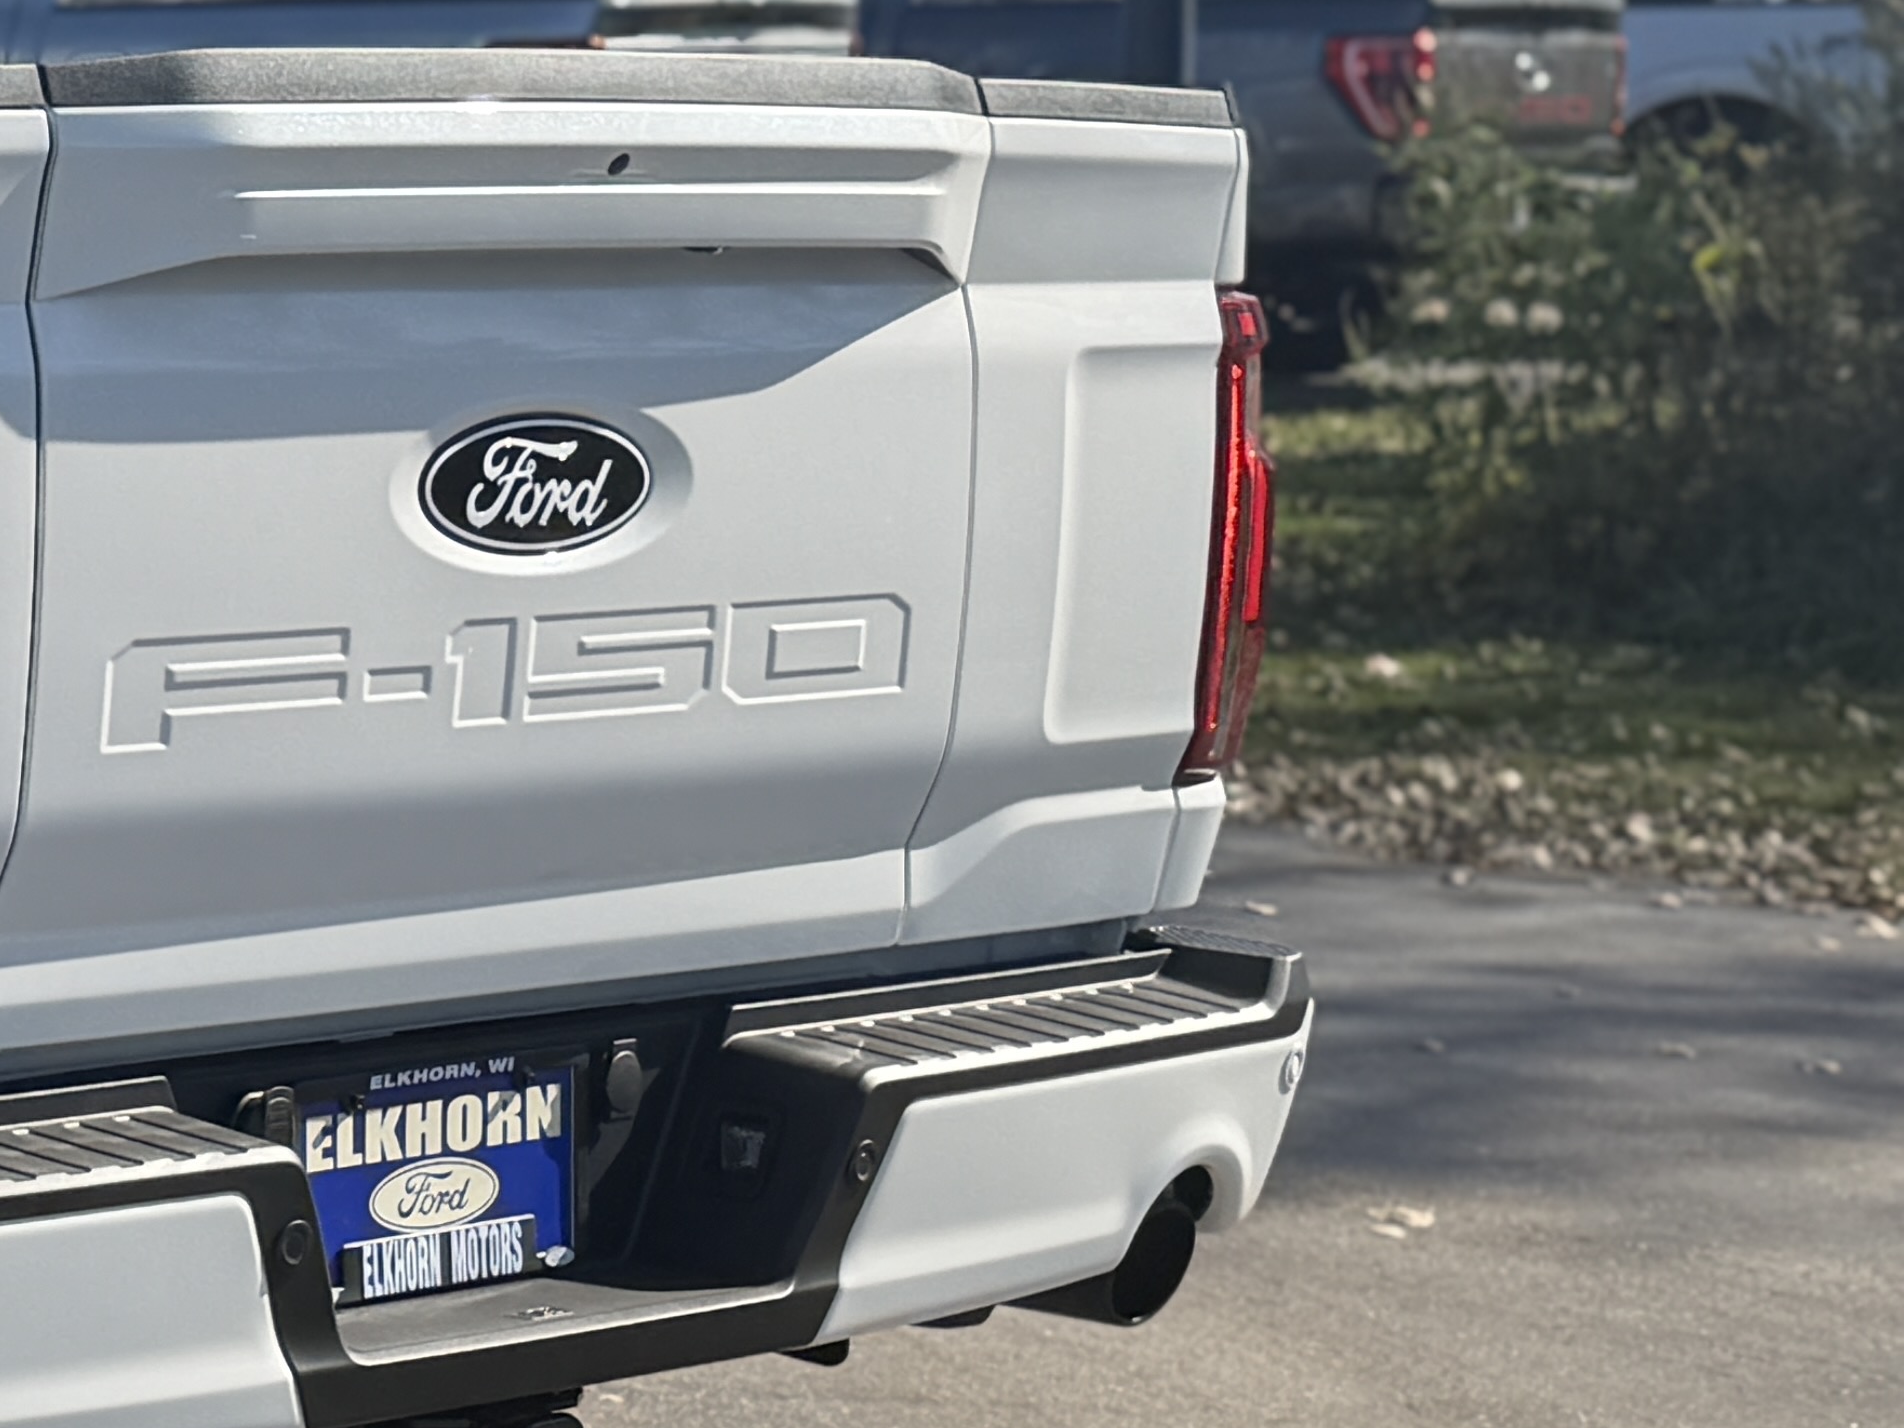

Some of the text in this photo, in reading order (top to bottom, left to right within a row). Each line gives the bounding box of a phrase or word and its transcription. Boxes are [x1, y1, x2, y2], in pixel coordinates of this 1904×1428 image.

[465, 435, 613, 530] Ford
[100, 592, 912, 754] F-150
[369, 1056, 515, 1090] ELKHORN, WI
[305, 1082, 563, 1173] ELKHORN
[397, 1170, 471, 1219] Ford
[362, 1220, 524, 1300] ELKHORN MOTORS
